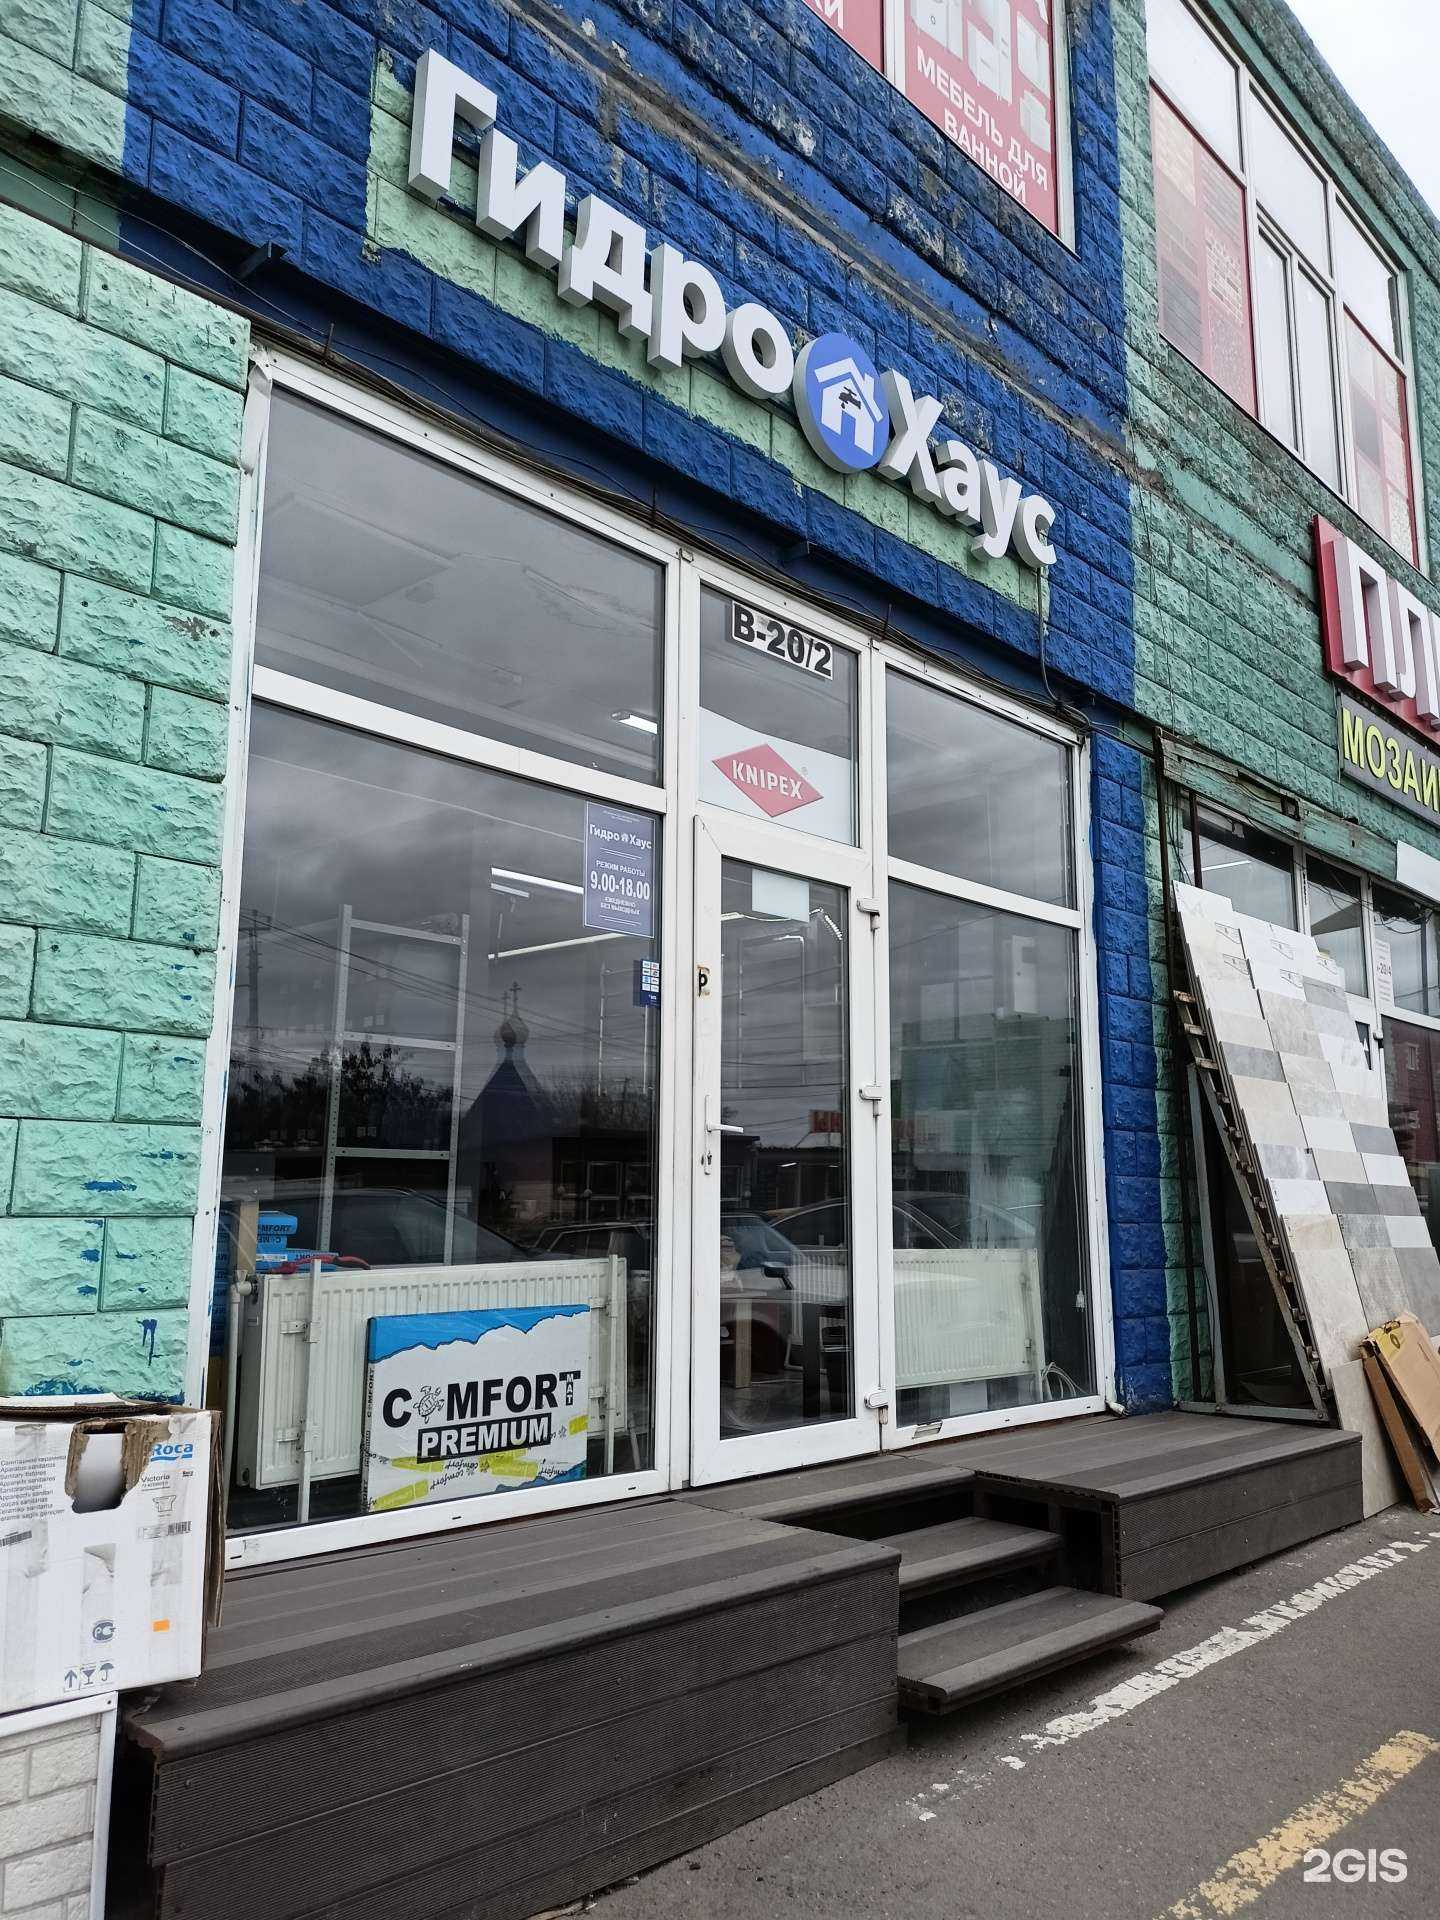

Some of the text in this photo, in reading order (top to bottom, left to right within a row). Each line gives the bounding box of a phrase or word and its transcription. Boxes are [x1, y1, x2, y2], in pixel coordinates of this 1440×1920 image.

[917, 46, 1048, 191] МЕБЕЛЬ ДЛЯ
[944, 108, 1027, 204] ВАННОЙ
[408, 48, 1057, 568] Гидро Хаус
[1338, 537, 1440, 728] ПЛ
[732, 759, 803, 800] KNIPEX
[1342, 706, 1440, 813] МОЗАИ
[589, 823, 652, 849] Гидро Хаус
[590, 870, 650, 901] 9.00-18.00
[596, 859, 646, 877] РЕЖИМ РАБОТЫ
[152, 1443, 193, 1456] Roca
[421, 1416, 550, 1459] PREMIUM
